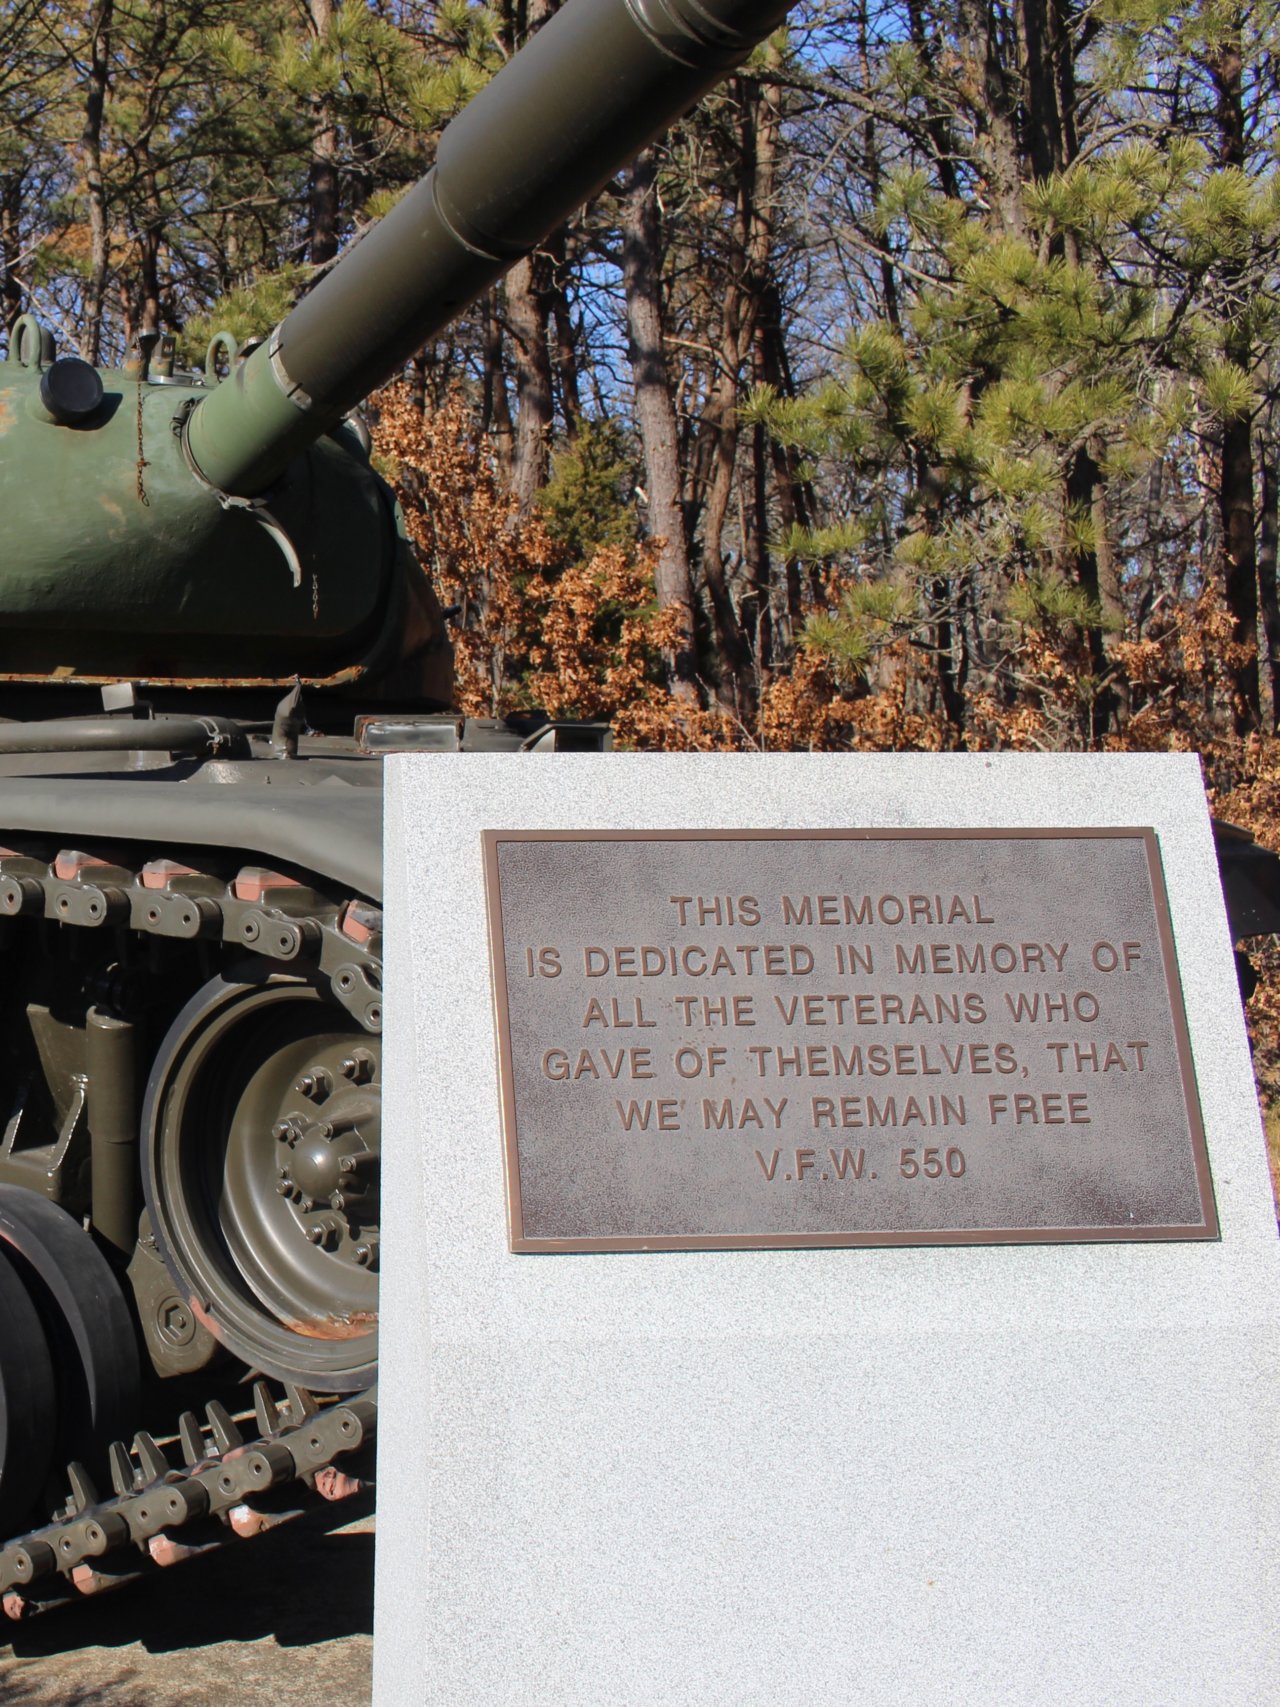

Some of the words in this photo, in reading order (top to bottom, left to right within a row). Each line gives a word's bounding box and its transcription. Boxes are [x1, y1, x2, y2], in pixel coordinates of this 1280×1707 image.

[670, 894, 763, 927] THIS
[783, 893, 996, 926] MEMORIAL
[527, 947, 563, 979] IS
[585, 944, 815, 978] DEDICATED
[838, 943, 874, 975] IN
[896, 942, 1069, 974] MEMORY
[1092, 941, 1142, 972] OF
[583, 997, 657, 1029] ALL
[675, 995, 756, 1028] THE
[775, 992, 987, 1027] VETERANS
[1010, 990, 1101, 1024] WHO
[542, 1048, 654, 1081] GAVE
[676, 1046, 727, 1079] OF
[750, 1043, 1029, 1078] THEMSELVES,
[1047, 1042, 1150, 1073] THAT
[617, 1099, 681, 1132] WE
[703, 1098, 789, 1130] MAY
[813, 1095, 967, 1128] REMAIN
[990, 1093, 1092, 1125] FREE
[756, 1149, 877, 1181] V.F.W.
[900, 1147, 967, 1179] 550
